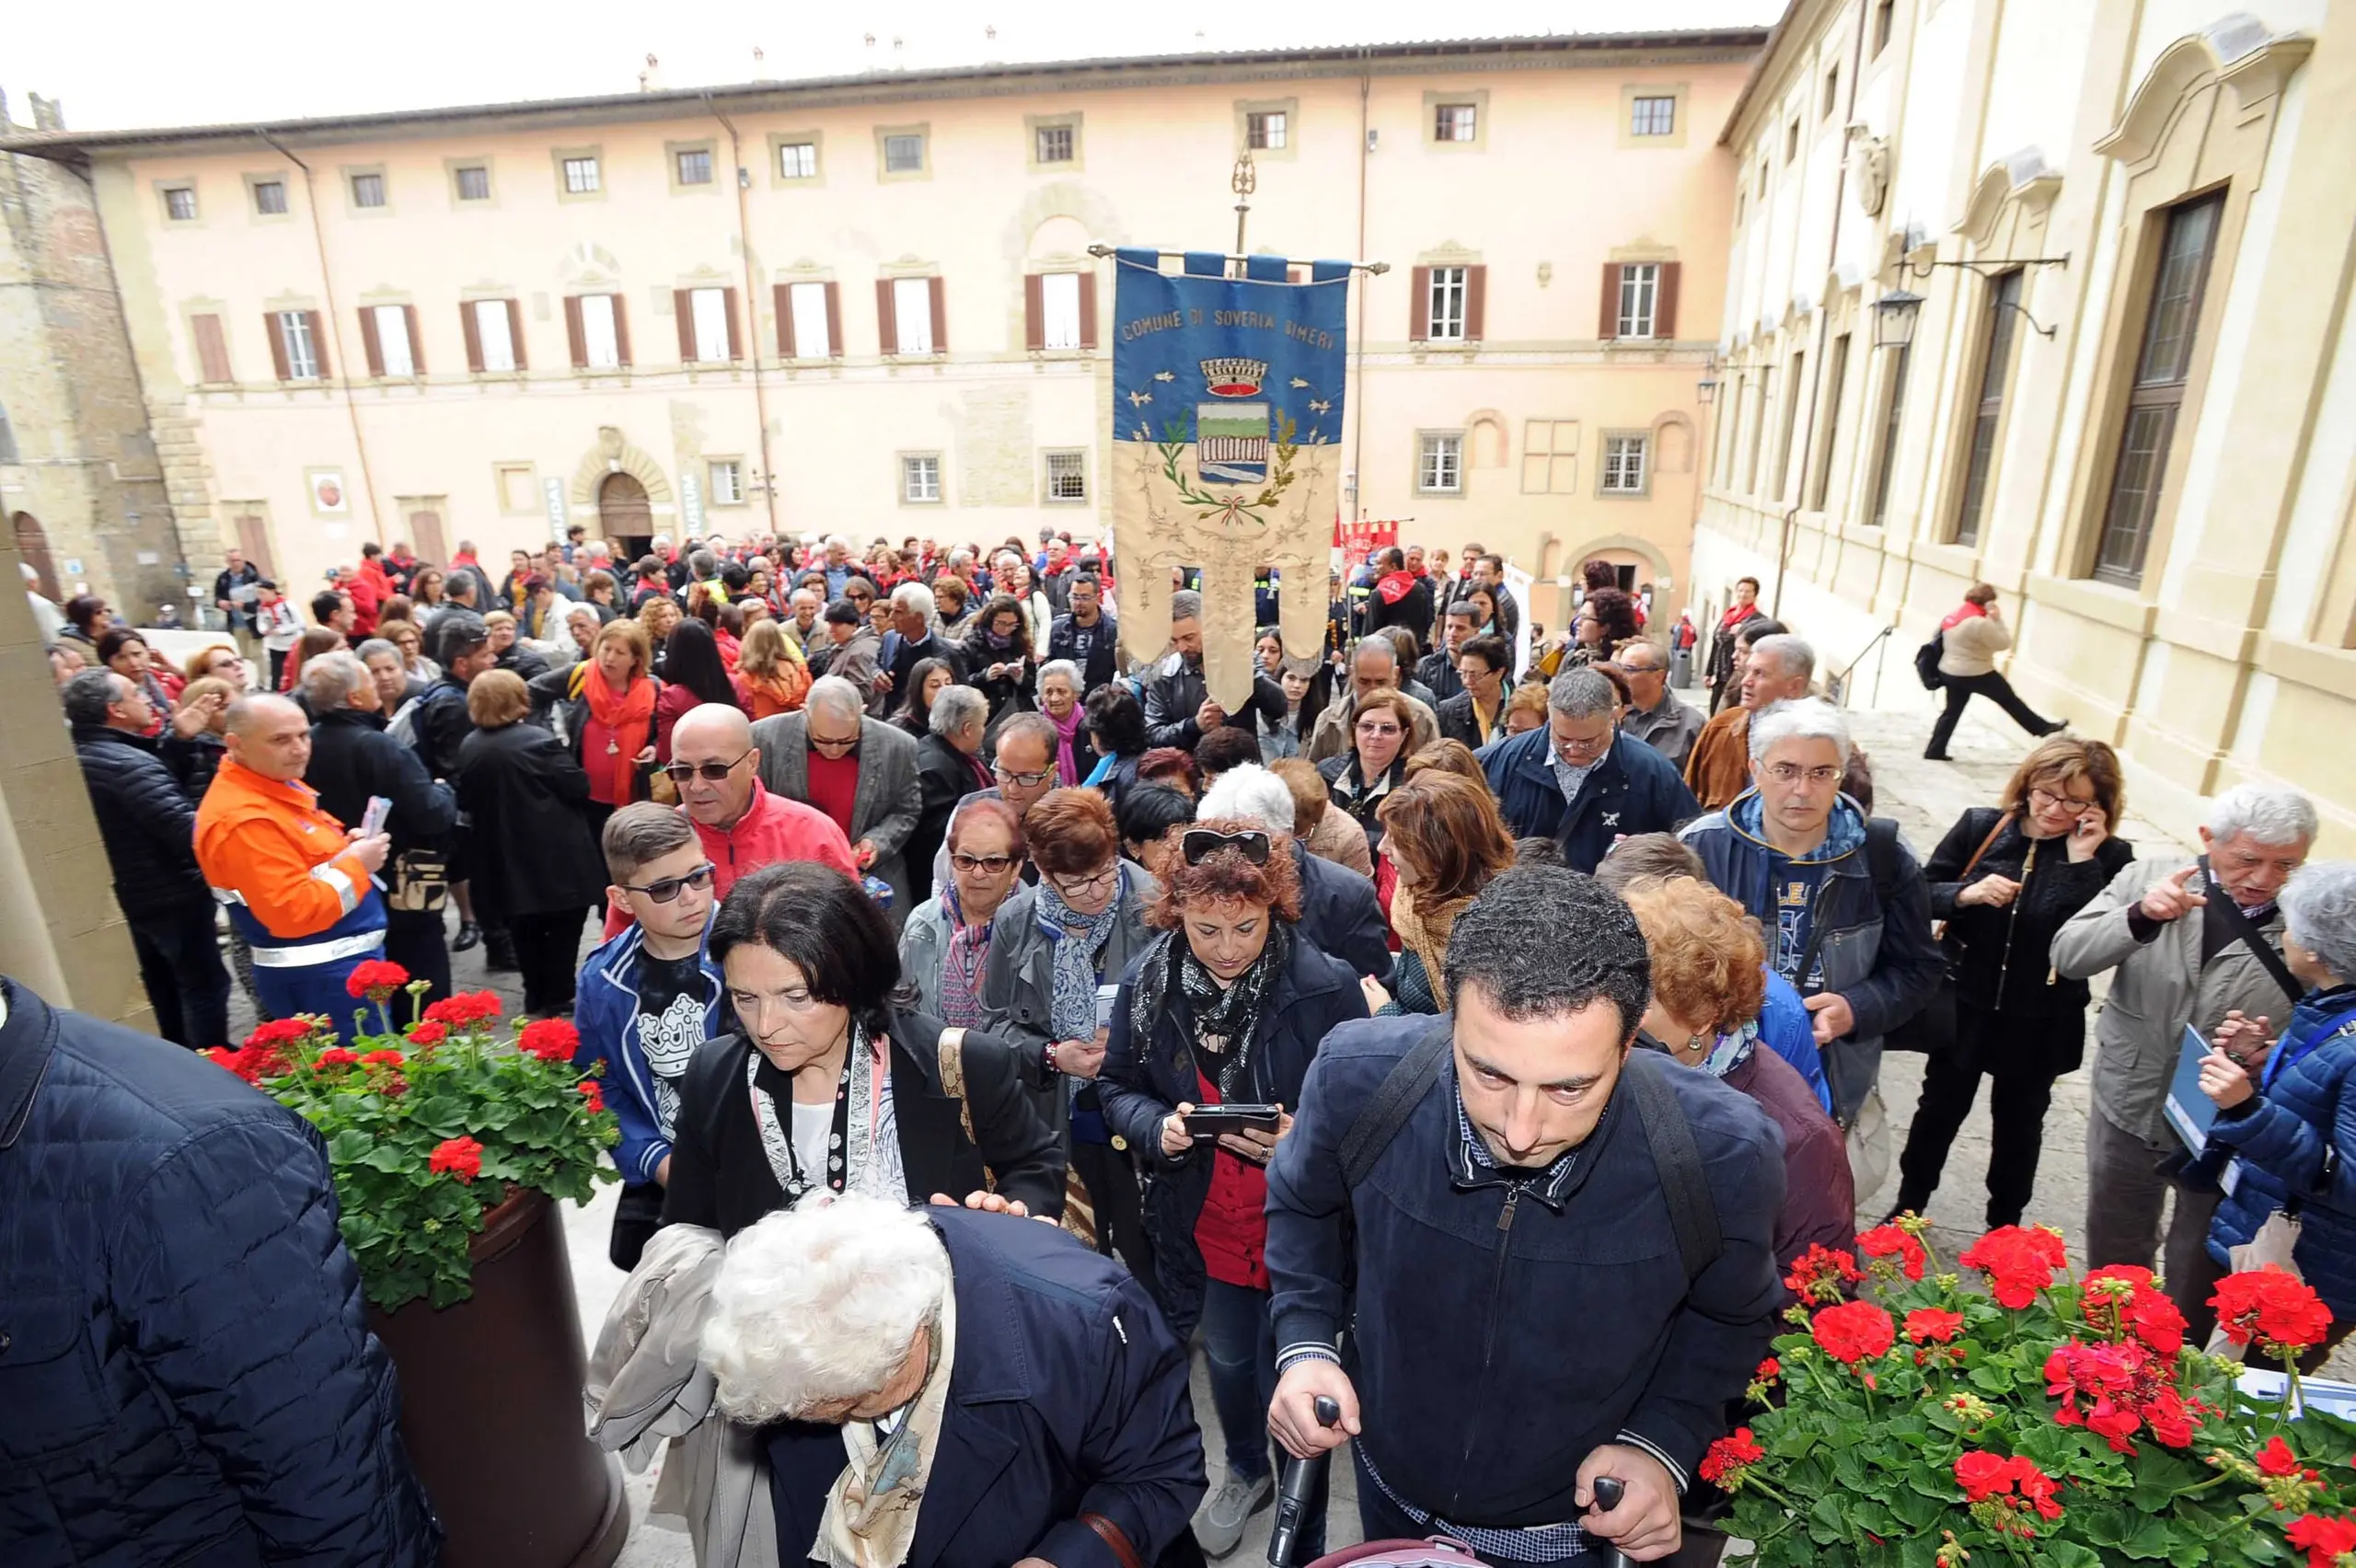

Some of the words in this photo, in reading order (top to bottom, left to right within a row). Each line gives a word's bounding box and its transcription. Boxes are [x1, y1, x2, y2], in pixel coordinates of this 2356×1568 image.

[1122, 310, 1183, 340] COMUNE
[1190, 308, 1203, 325] DI
[1215, 309, 1275, 329] SOVERIA
